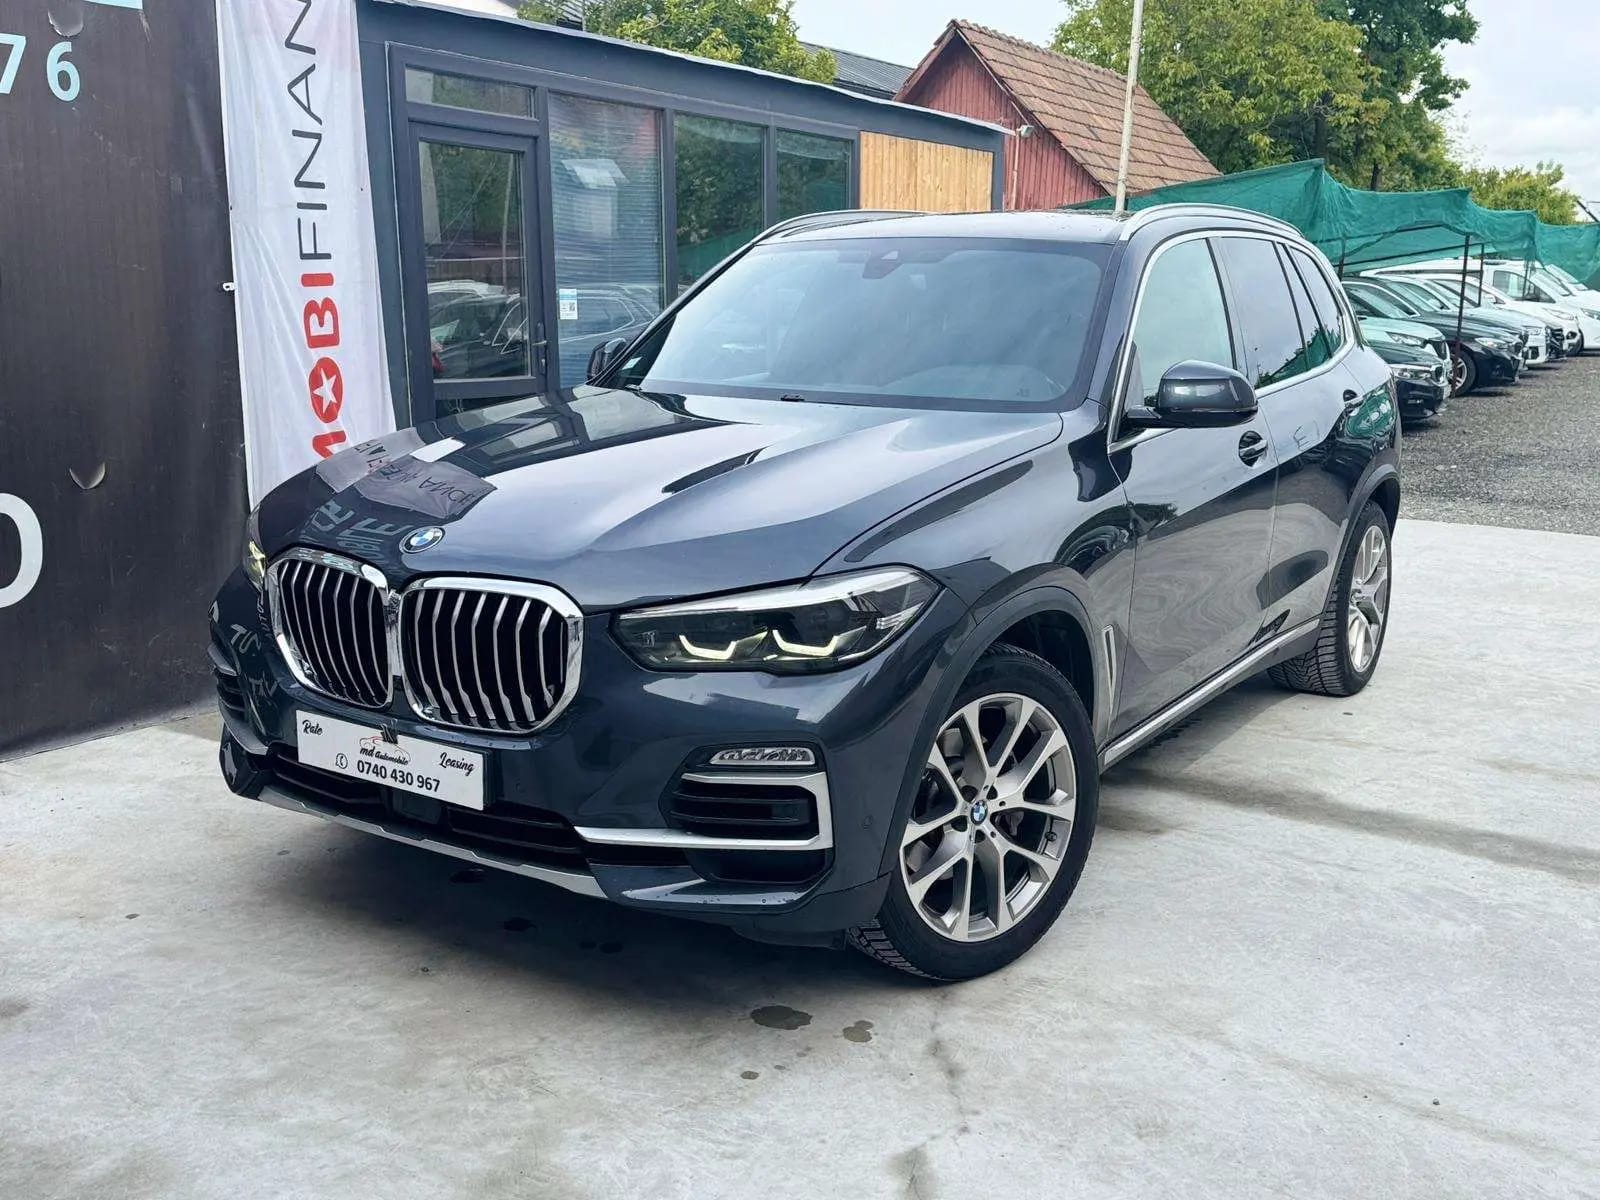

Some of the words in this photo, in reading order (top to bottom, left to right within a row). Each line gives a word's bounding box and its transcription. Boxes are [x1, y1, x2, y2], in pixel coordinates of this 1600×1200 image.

[302, 719, 324, 736] Rate
[360, 746, 376, 758] md
[439, 751, 475, 777] Leasing
[357, 759, 388, 780] 0740
[390, 768, 414, 786] 430
[416, 774, 441, 793] 967
